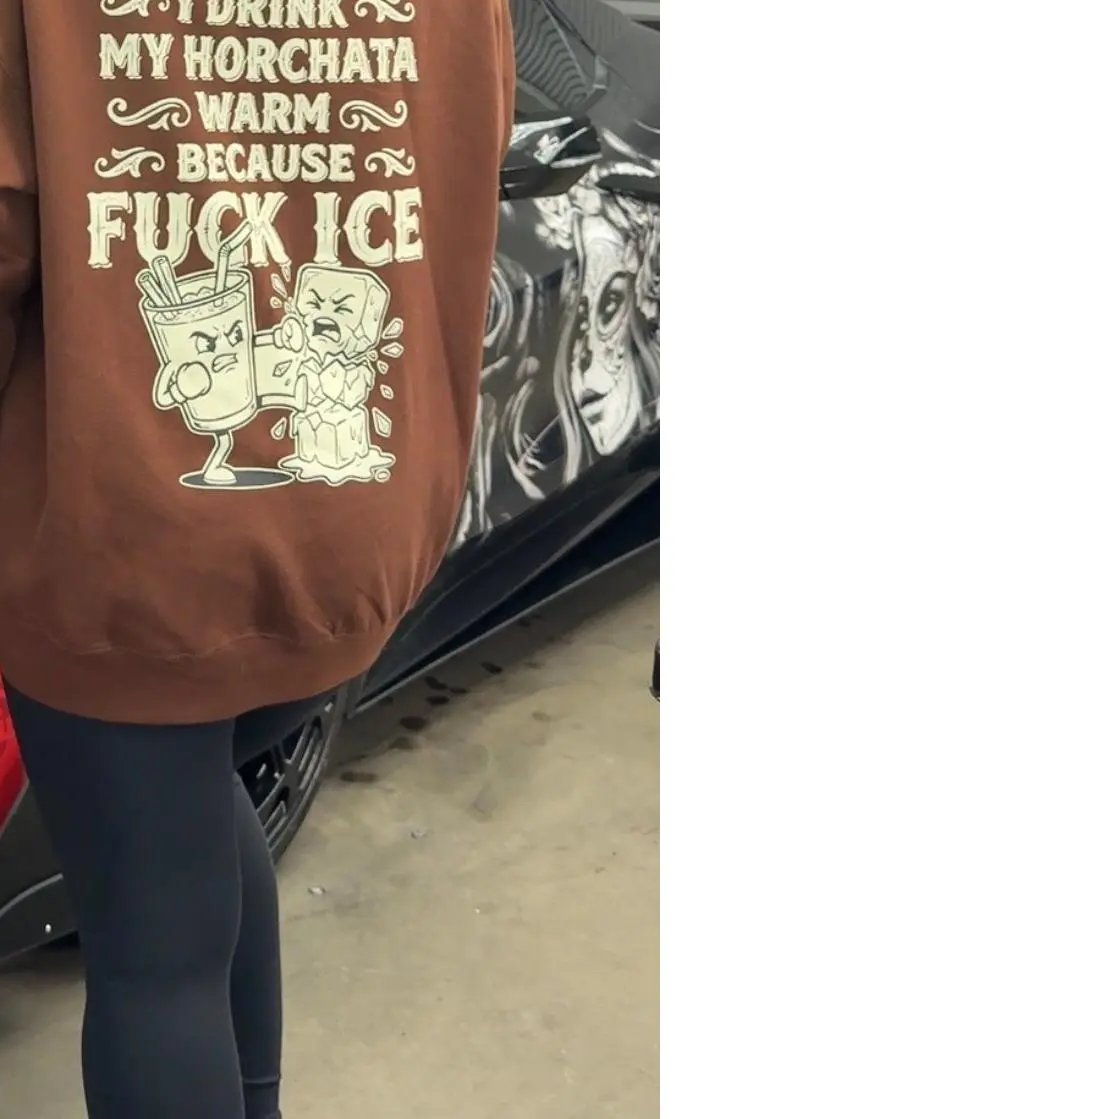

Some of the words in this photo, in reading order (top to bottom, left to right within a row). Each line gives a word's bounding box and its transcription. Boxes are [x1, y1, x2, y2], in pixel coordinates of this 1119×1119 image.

[98, 33, 174, 80] MY
[183, 35, 419, 83] HORCHATA
[194, 91, 331, 134] WARM
[176, 142, 356, 182] BECAUSE
[86, 190, 292, 269] FUCK
[313, 186, 423, 267] ICE
